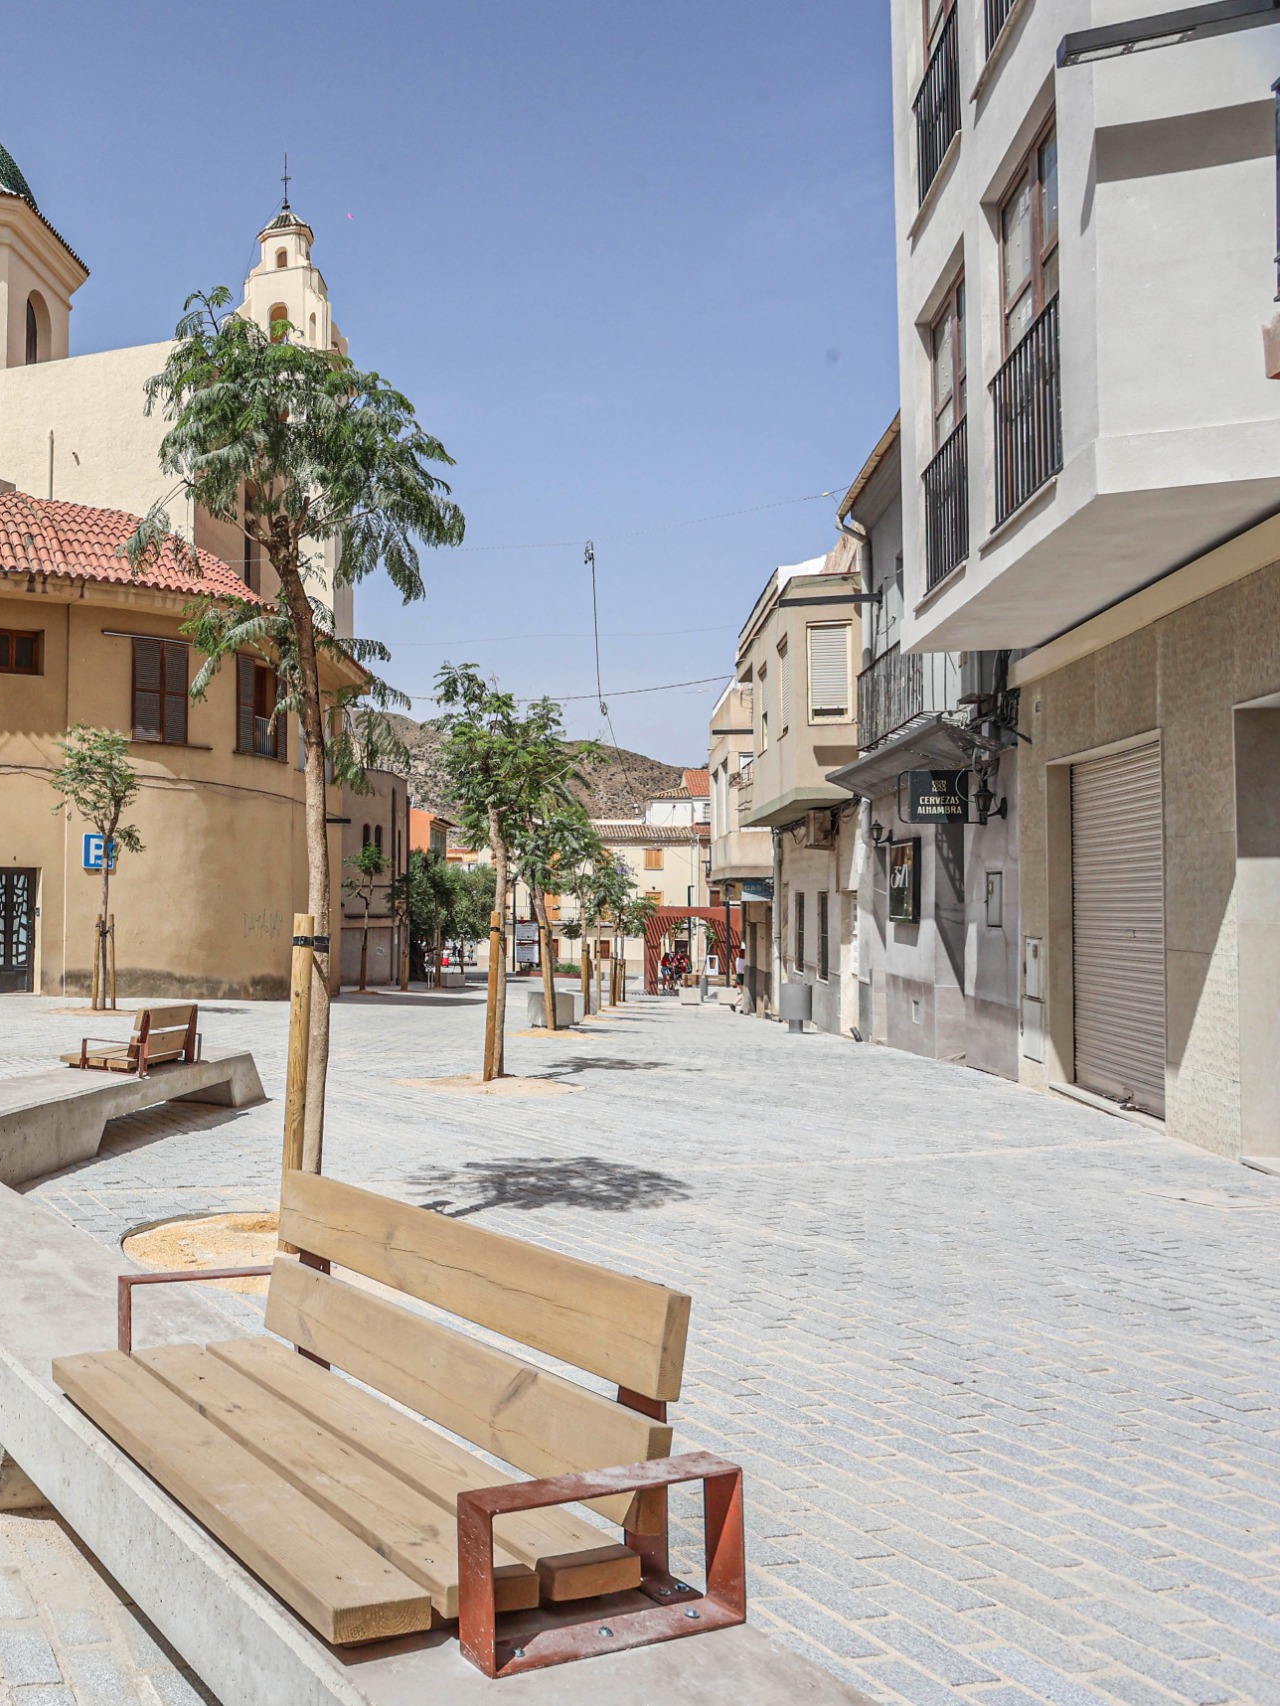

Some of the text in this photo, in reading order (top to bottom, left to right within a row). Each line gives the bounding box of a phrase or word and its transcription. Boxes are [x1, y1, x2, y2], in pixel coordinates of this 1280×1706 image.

[919, 796, 959, 804] CERVEZAS
[917, 806, 962, 814] ALHAMBRA
[89, 838, 107, 864] P
